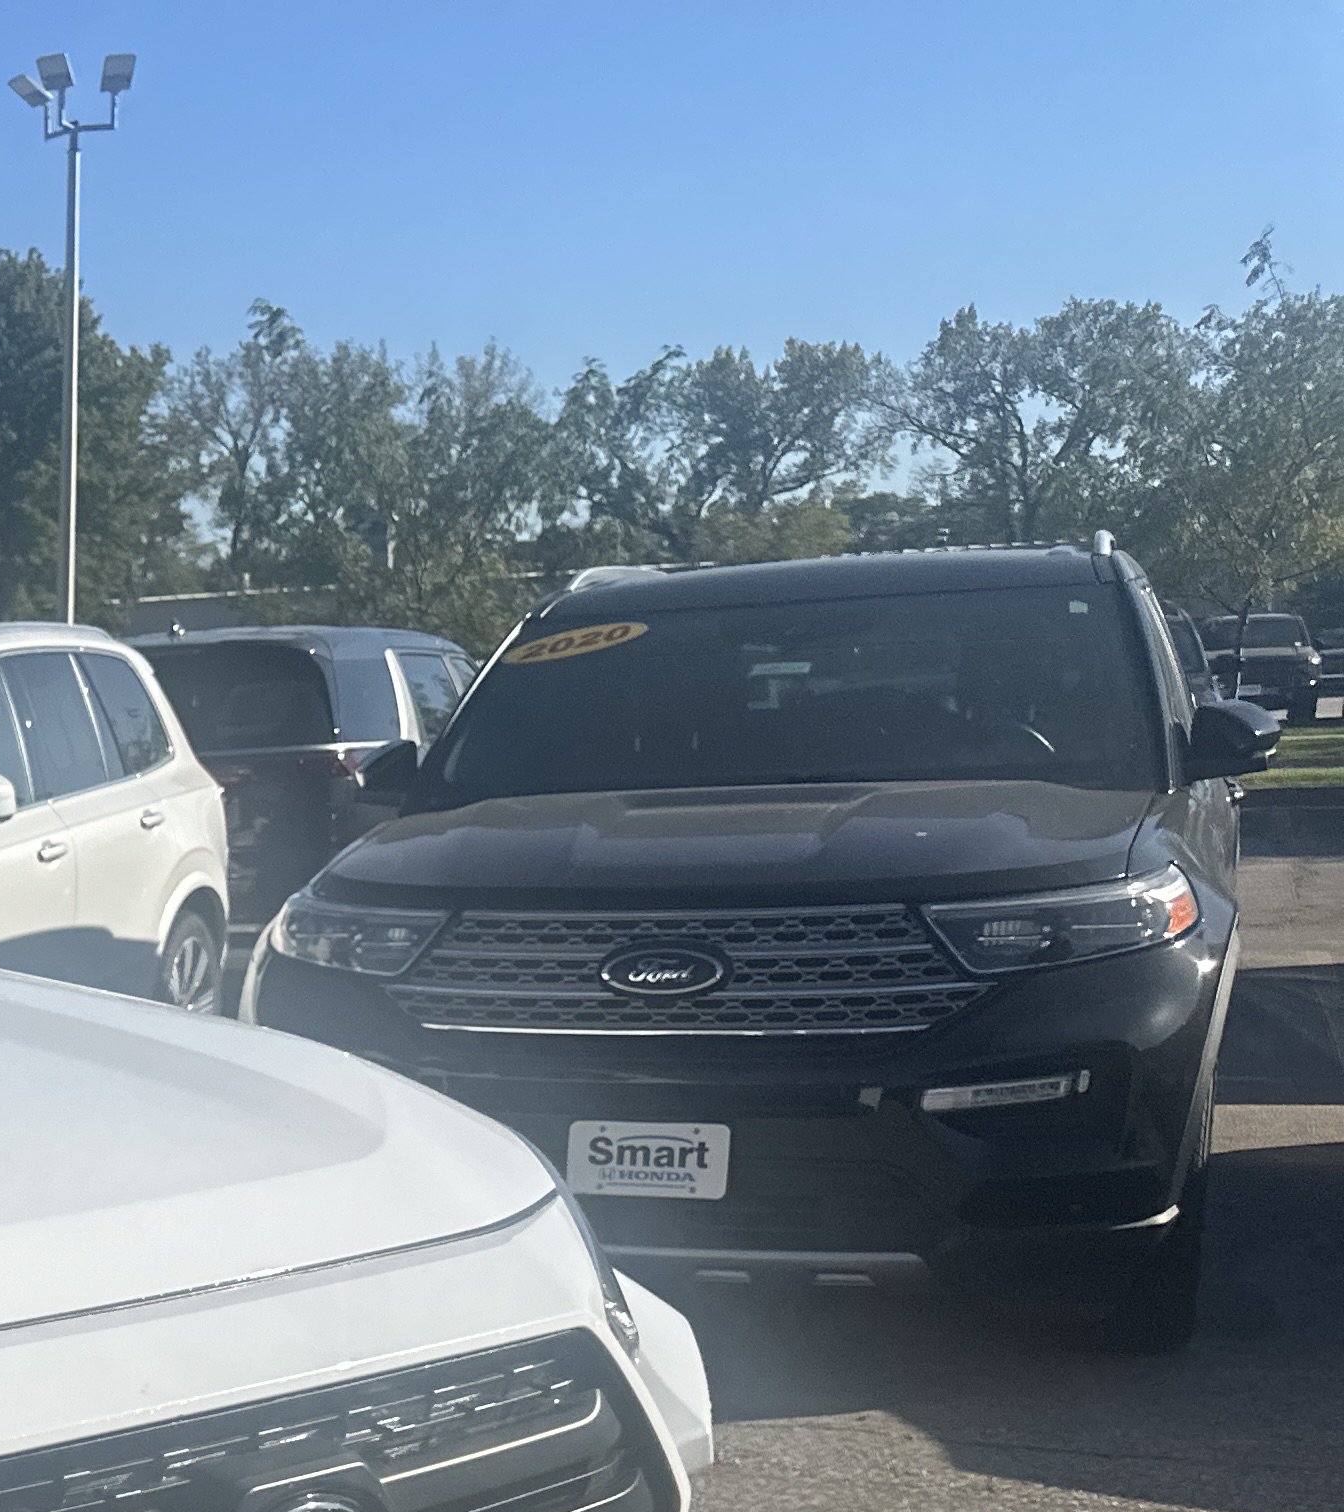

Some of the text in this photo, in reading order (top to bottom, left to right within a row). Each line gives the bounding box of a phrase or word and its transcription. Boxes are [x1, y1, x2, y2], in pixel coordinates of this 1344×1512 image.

[520, 625, 631, 660] 2020
[628, 957, 694, 984] Ford
[587, 1135, 710, 1169] Smart
[617, 1168, 696, 1183] HONDA
